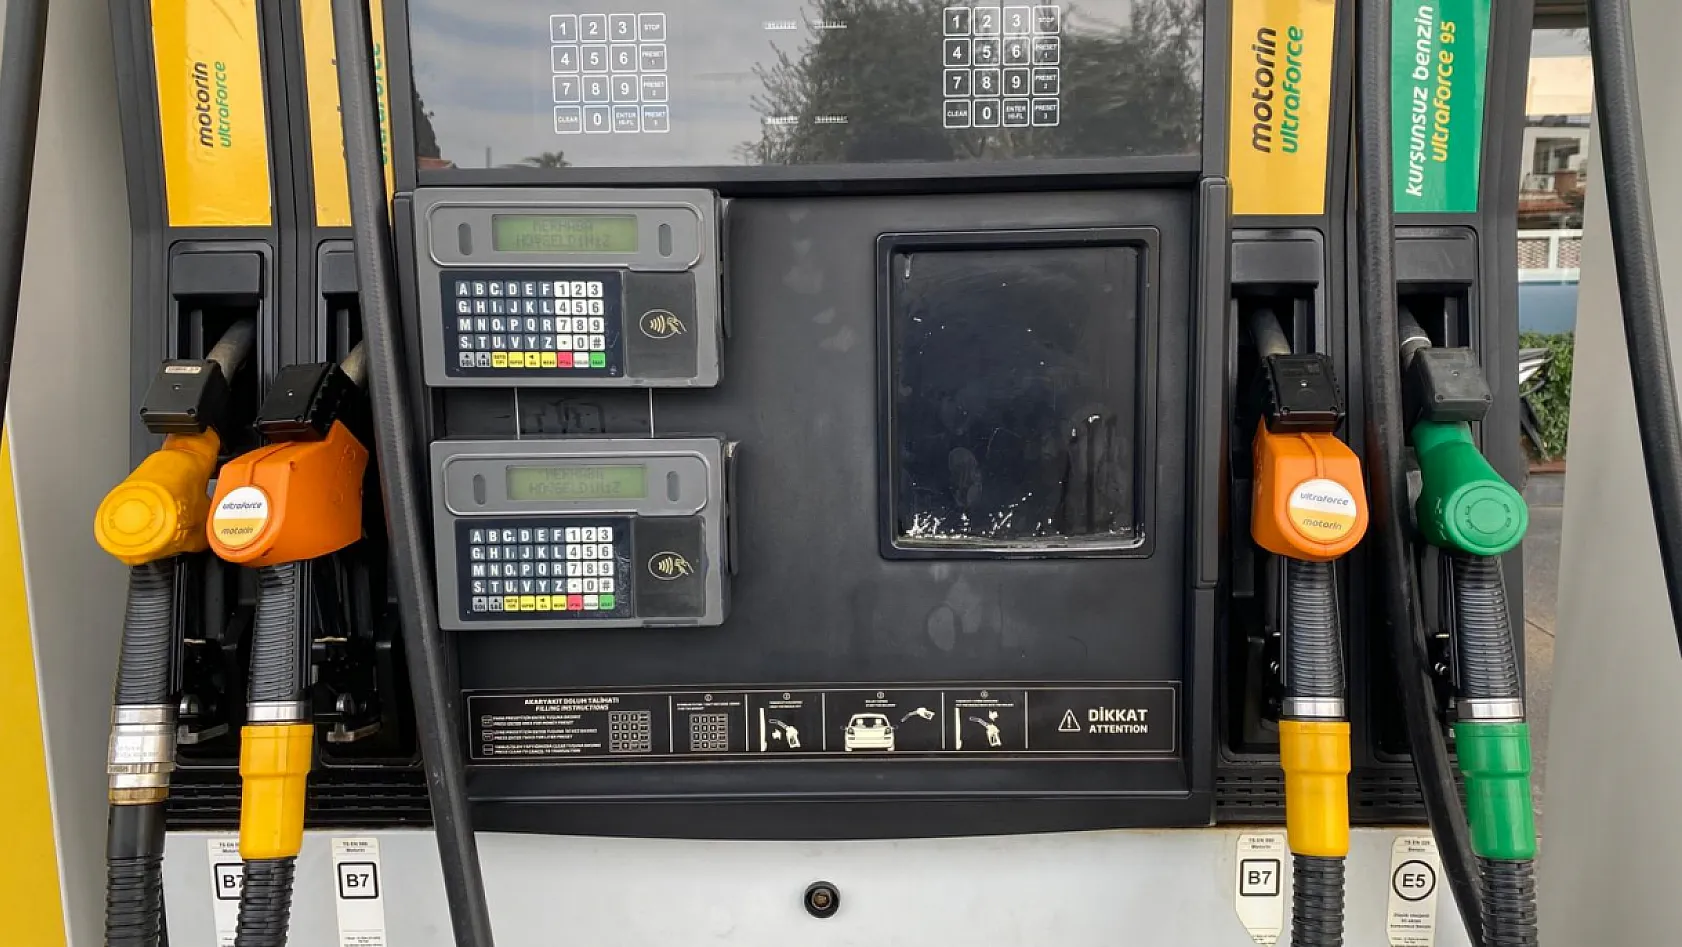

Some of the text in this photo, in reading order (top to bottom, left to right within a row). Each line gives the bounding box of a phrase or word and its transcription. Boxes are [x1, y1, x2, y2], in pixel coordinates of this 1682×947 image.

[560, 21, 627, 35] 1 2 3
[952, 14, 1021, 29] 1 2 3
[561, 52, 628, 65] 4 5 6
[952, 45, 1021, 59] 4 5 6
[562, 83, 629, 95] 7 8 9
[953, 76, 1021, 89] 7 8 9
[1252, 27, 1276, 153] motorin
[1280, 26, 1304, 154] ultraforce
[1431, 21, 1456, 162] ultraforce 95
[192, 61, 214, 148] motorin
[214, 61, 232, 148] ultraforce
[1406, 5, 1433, 196] kurşunsuz benzin
[593, 113, 601, 126] 0
[982, 107, 991, 119] 0
[459, 283, 468, 295] A
[476, 283, 484, 295] B
[510, 284, 517, 295] D
[526, 284, 533, 295] E
[543, 284, 550, 295] F
[559, 284, 565, 294] 1
[575, 284, 583, 294] 2
[591, 284, 598, 294] 3
[477, 301, 485, 313] H
[510, 301, 518, 312] J
[526, 301, 534, 312] K
[543, 301, 550, 313] L
[559, 302, 566, 312] 4
[576, 302, 583, 312] 5
[592, 302, 599, 312] 6
[460, 319, 471, 330] M
[478, 319, 486, 330] N
[511, 319, 518, 330] P
[527, 319, 536, 330] Q
[543, 319, 551, 330] R
[560, 320, 567, 330] 7
[576, 320, 584, 330] 8
[593, 320, 600, 330] 9
[478, 336, 486, 348] T
[511, 336, 519, 348] V
[527, 336, 536, 348] Y
[545, 336, 552, 348] Z
[577, 338, 584, 347] 0
[593, 338, 602, 347] #
[222, 501, 262, 510] ultraforce
[1300, 492, 1348, 506] ultraforce
[221, 526, 254, 535] motorin
[1302, 518, 1342, 530] motorin
[473, 531, 482, 542] A
[489, 531, 496, 542] B
[521, 531, 528, 542] D
[538, 530, 544, 541] E
[554, 530, 561, 541] F
[571, 530, 576, 540] 1
[586, 530, 593, 540] 2
[602, 530, 608, 539] 3
[490, 548, 498, 559] H
[522, 548, 529, 558] J
[538, 548, 545, 558] K
[554, 548, 561, 558] L
[570, 547, 577, 557] 4
[586, 547, 593, 557] 5
[602, 547, 609, 556] 6
[474, 566, 484, 576] M
[491, 566, 498, 576] N
[523, 565, 530, 576] P
[539, 565, 546, 576] Q
[554, 565, 562, 575] R
[570, 565, 578, 574] 7
[587, 565, 594, 574] 8
[602, 565, 609, 574] 9
[491, 582, 498, 593] T
[523, 582, 530, 592] V
[539, 582, 546, 592] Y
[555, 582, 562, 592] Z
[587, 582, 594, 591] 0
[602, 582, 610, 591] #
[1088, 706, 1148, 722] DİKKAT
[1089, 724, 1148, 734] ATTENTION
[224, 874, 243, 888] B7
[346, 873, 370, 888] B7
[1248, 870, 1272, 886] B7
[1402, 873, 1426, 888] E5
